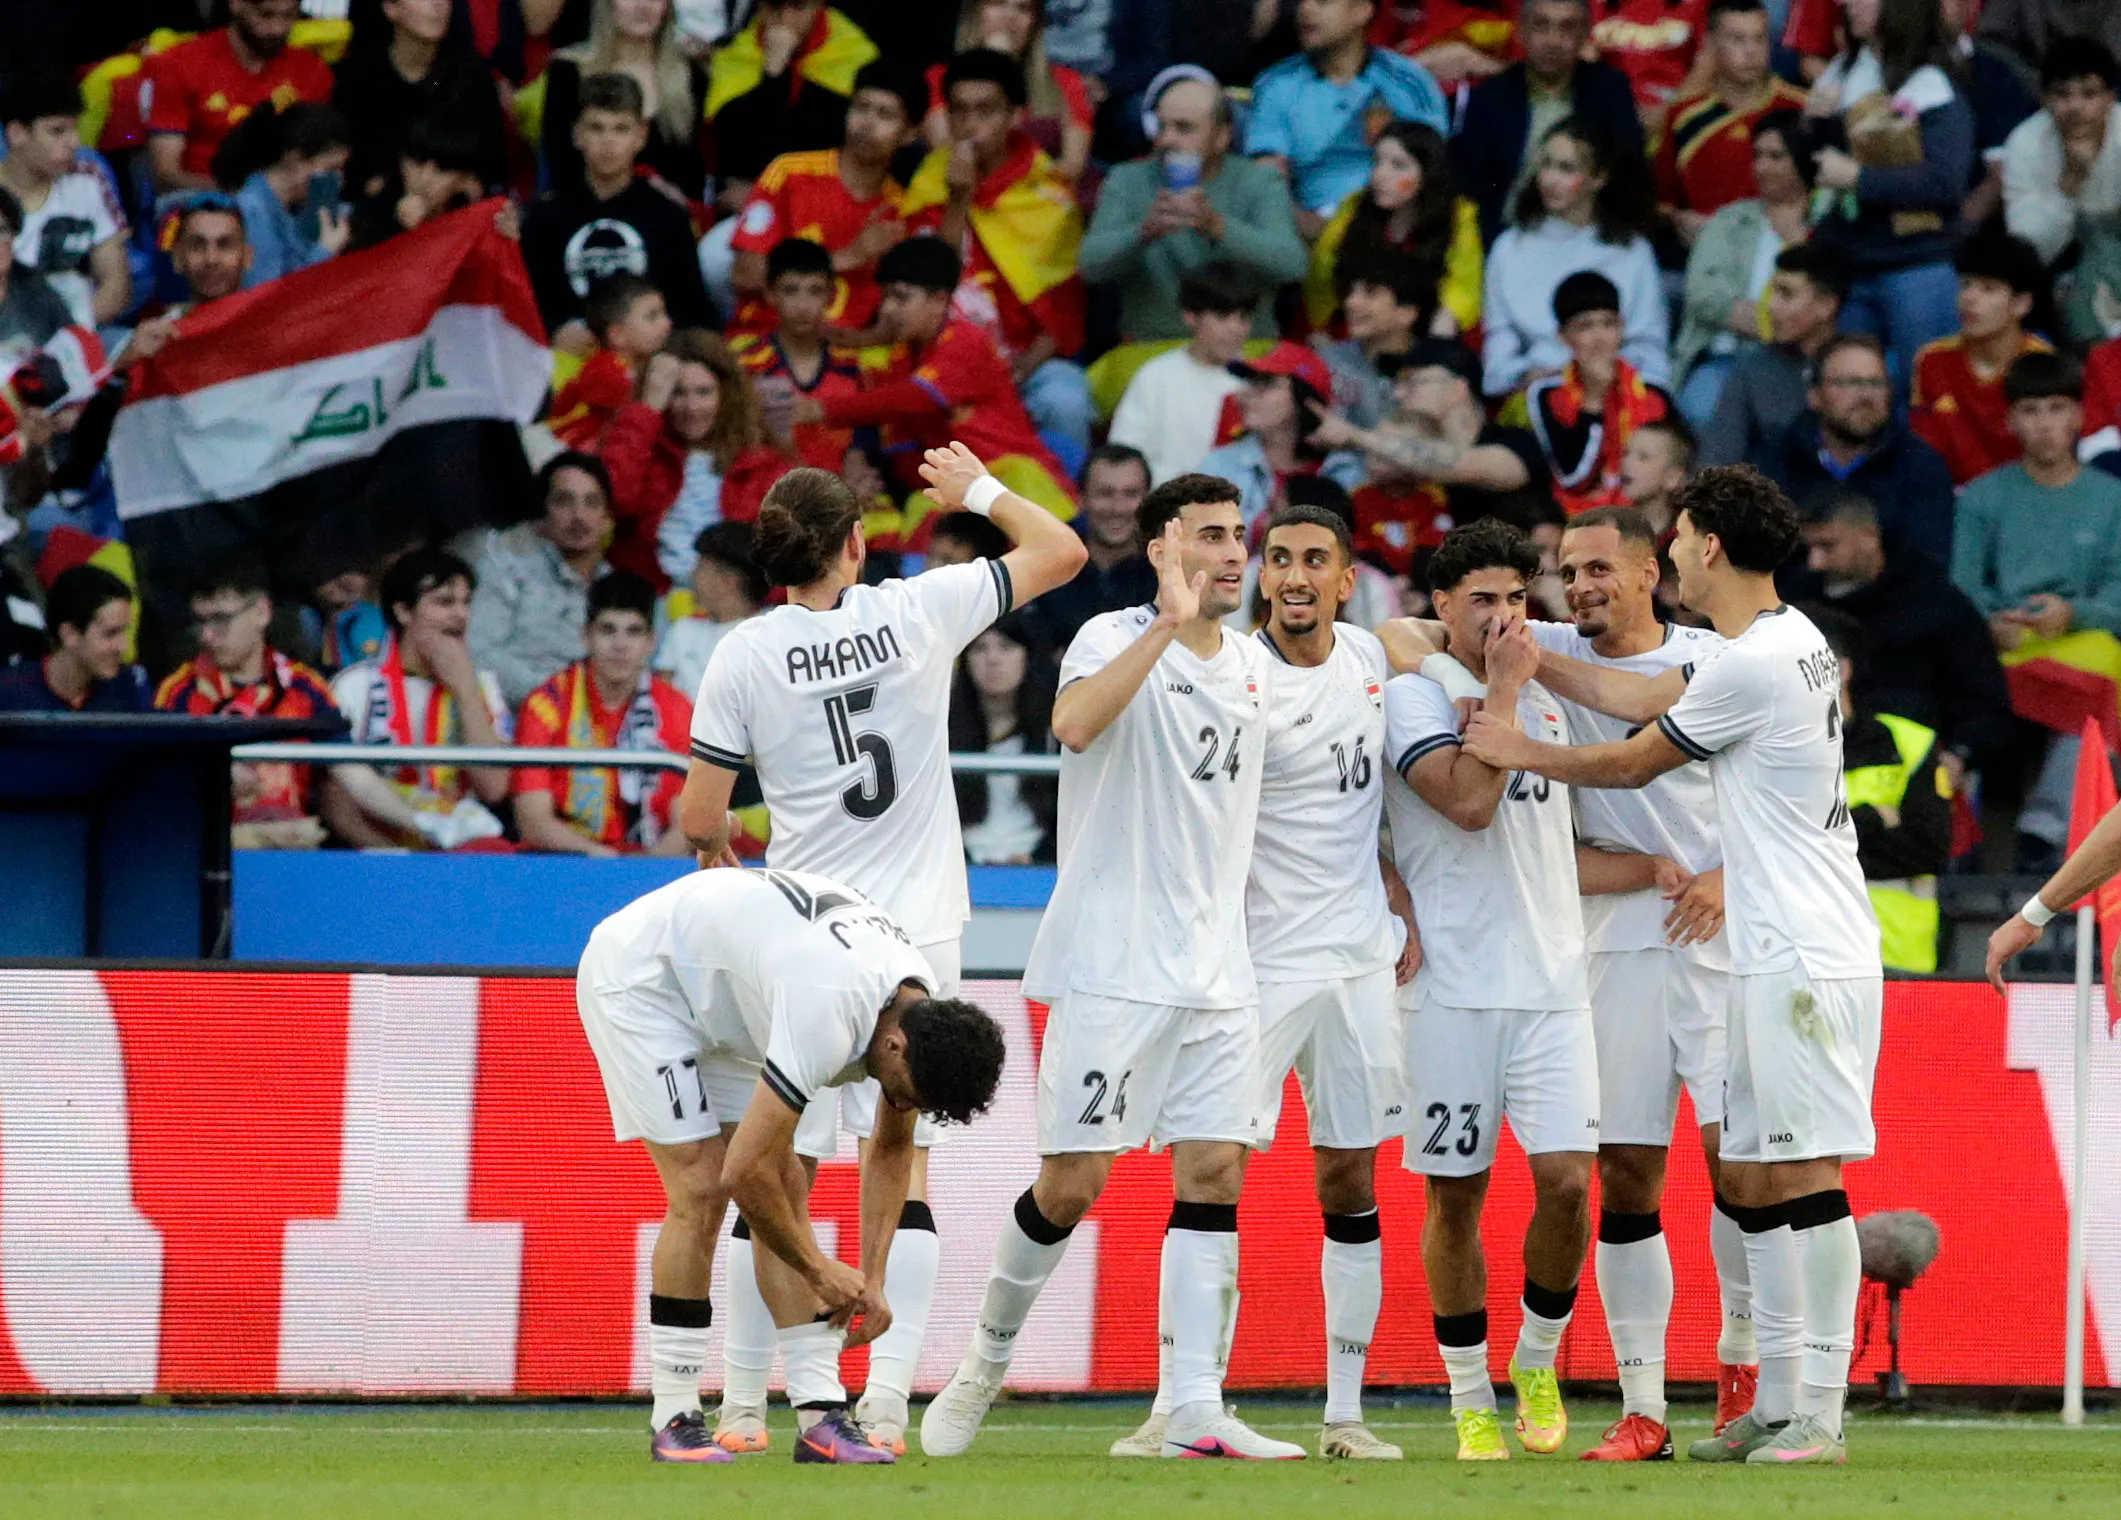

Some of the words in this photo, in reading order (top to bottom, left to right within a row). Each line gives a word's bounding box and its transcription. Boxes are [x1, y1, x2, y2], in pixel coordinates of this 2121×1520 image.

[786, 624, 902, 684] AKAM
[823, 681, 899, 823] 5
[1190, 725, 1242, 783] 24
[1328, 735, 1371, 793] 16
[656, 1057, 708, 1120] 17
[1077, 1068, 1133, 1126] 24
[1421, 1101, 1484, 1157] 23
